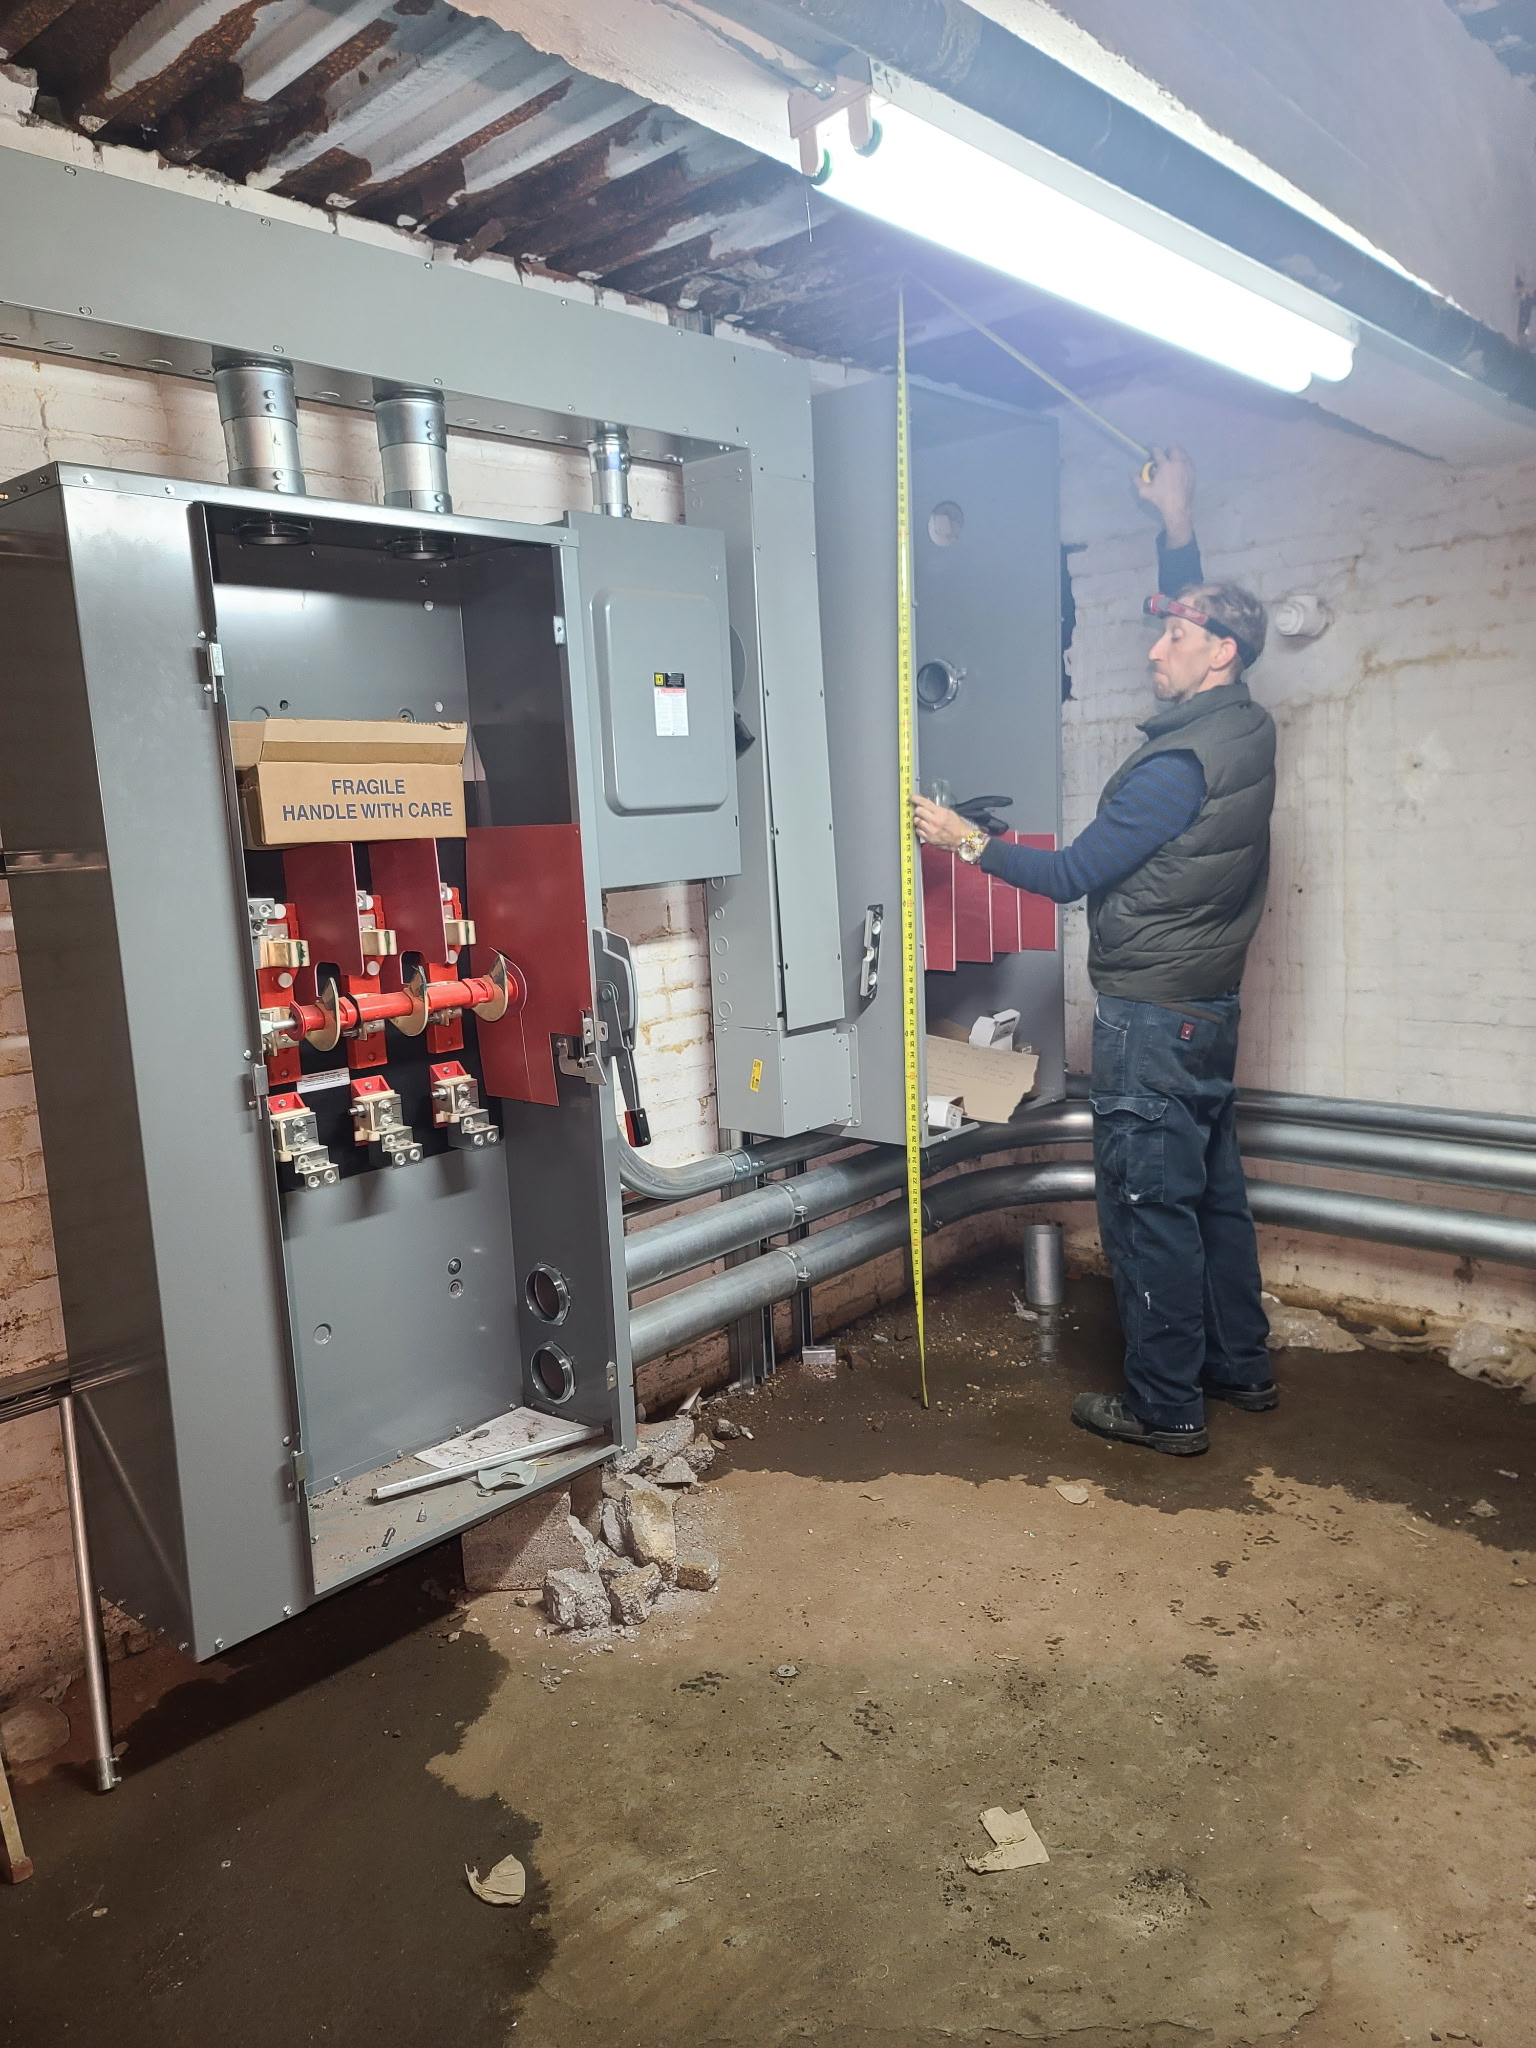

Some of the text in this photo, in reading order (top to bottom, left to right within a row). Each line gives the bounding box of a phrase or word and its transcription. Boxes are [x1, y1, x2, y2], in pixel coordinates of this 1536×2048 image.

[331, 779, 406, 795] FRAGILE
[282, 801, 453, 821] HANDLE WITH CARE
